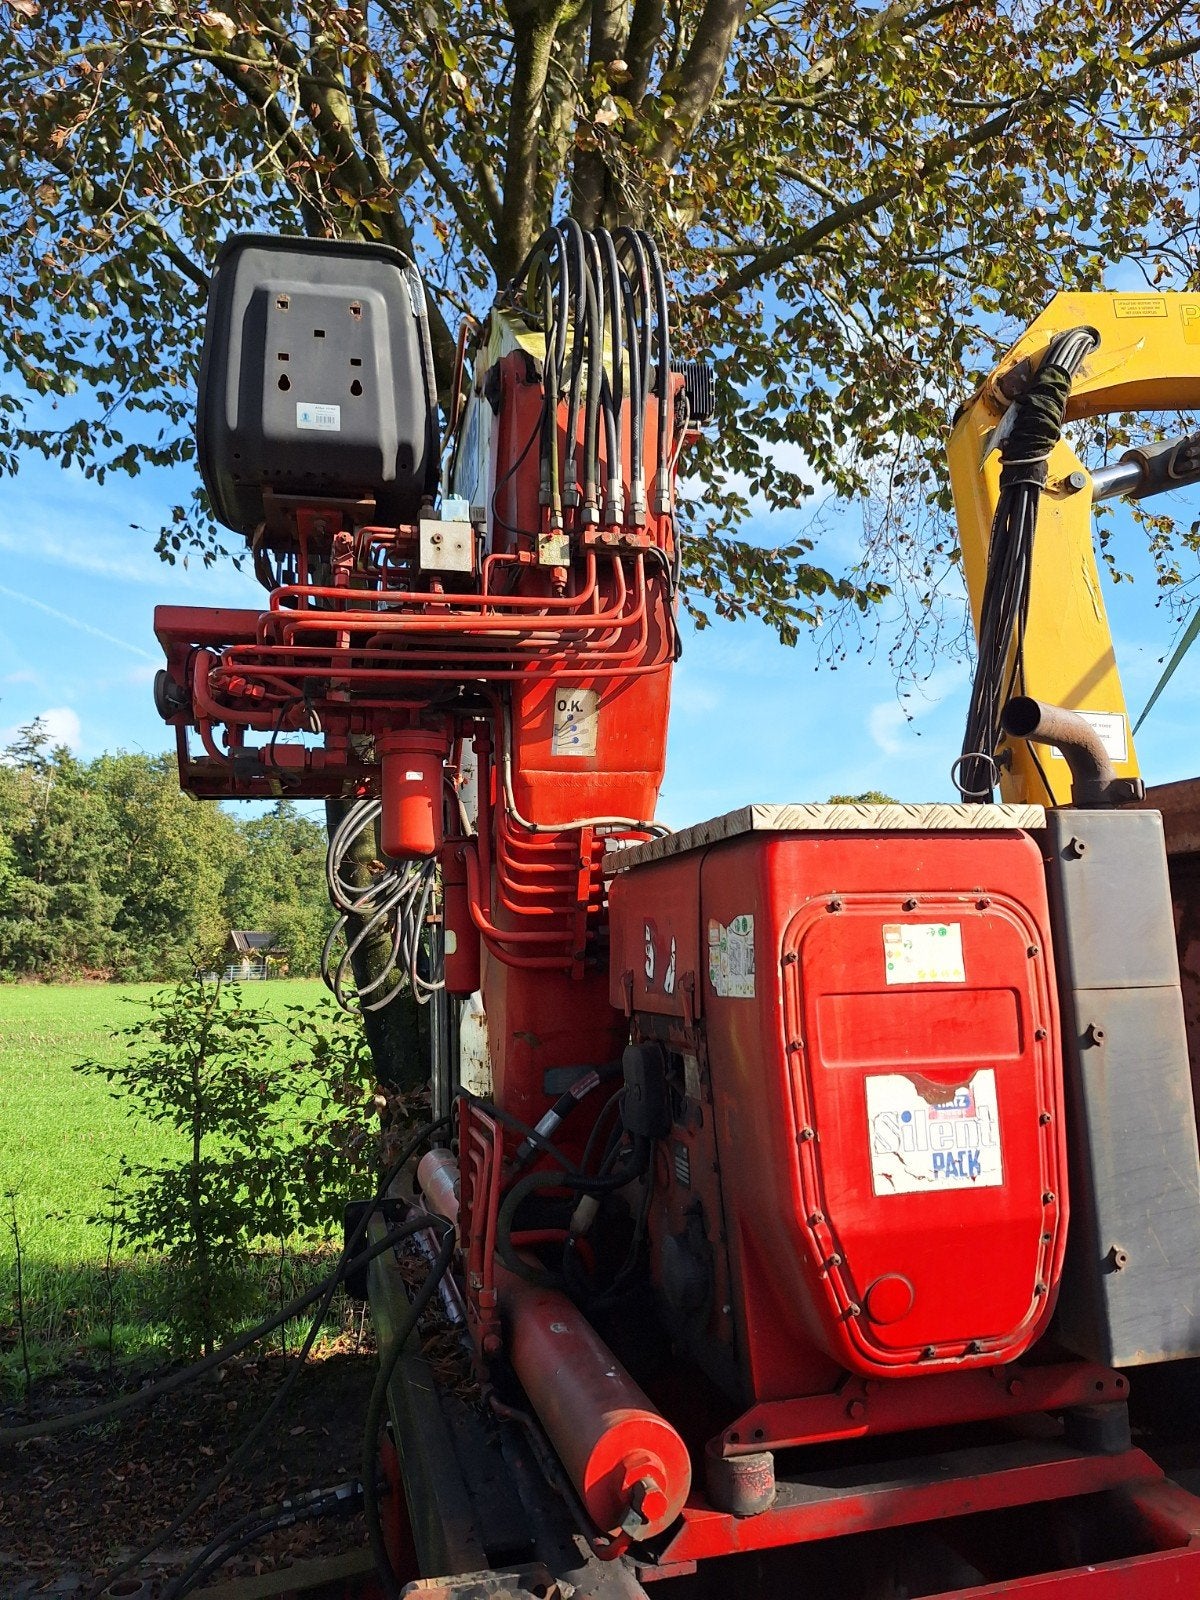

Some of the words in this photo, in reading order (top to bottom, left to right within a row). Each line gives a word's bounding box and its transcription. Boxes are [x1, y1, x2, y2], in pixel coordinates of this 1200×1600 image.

[557, 699, 584, 713] O.K.
[873, 1105, 996, 1154] Silent
[932, 1149, 981, 1178] PACK
